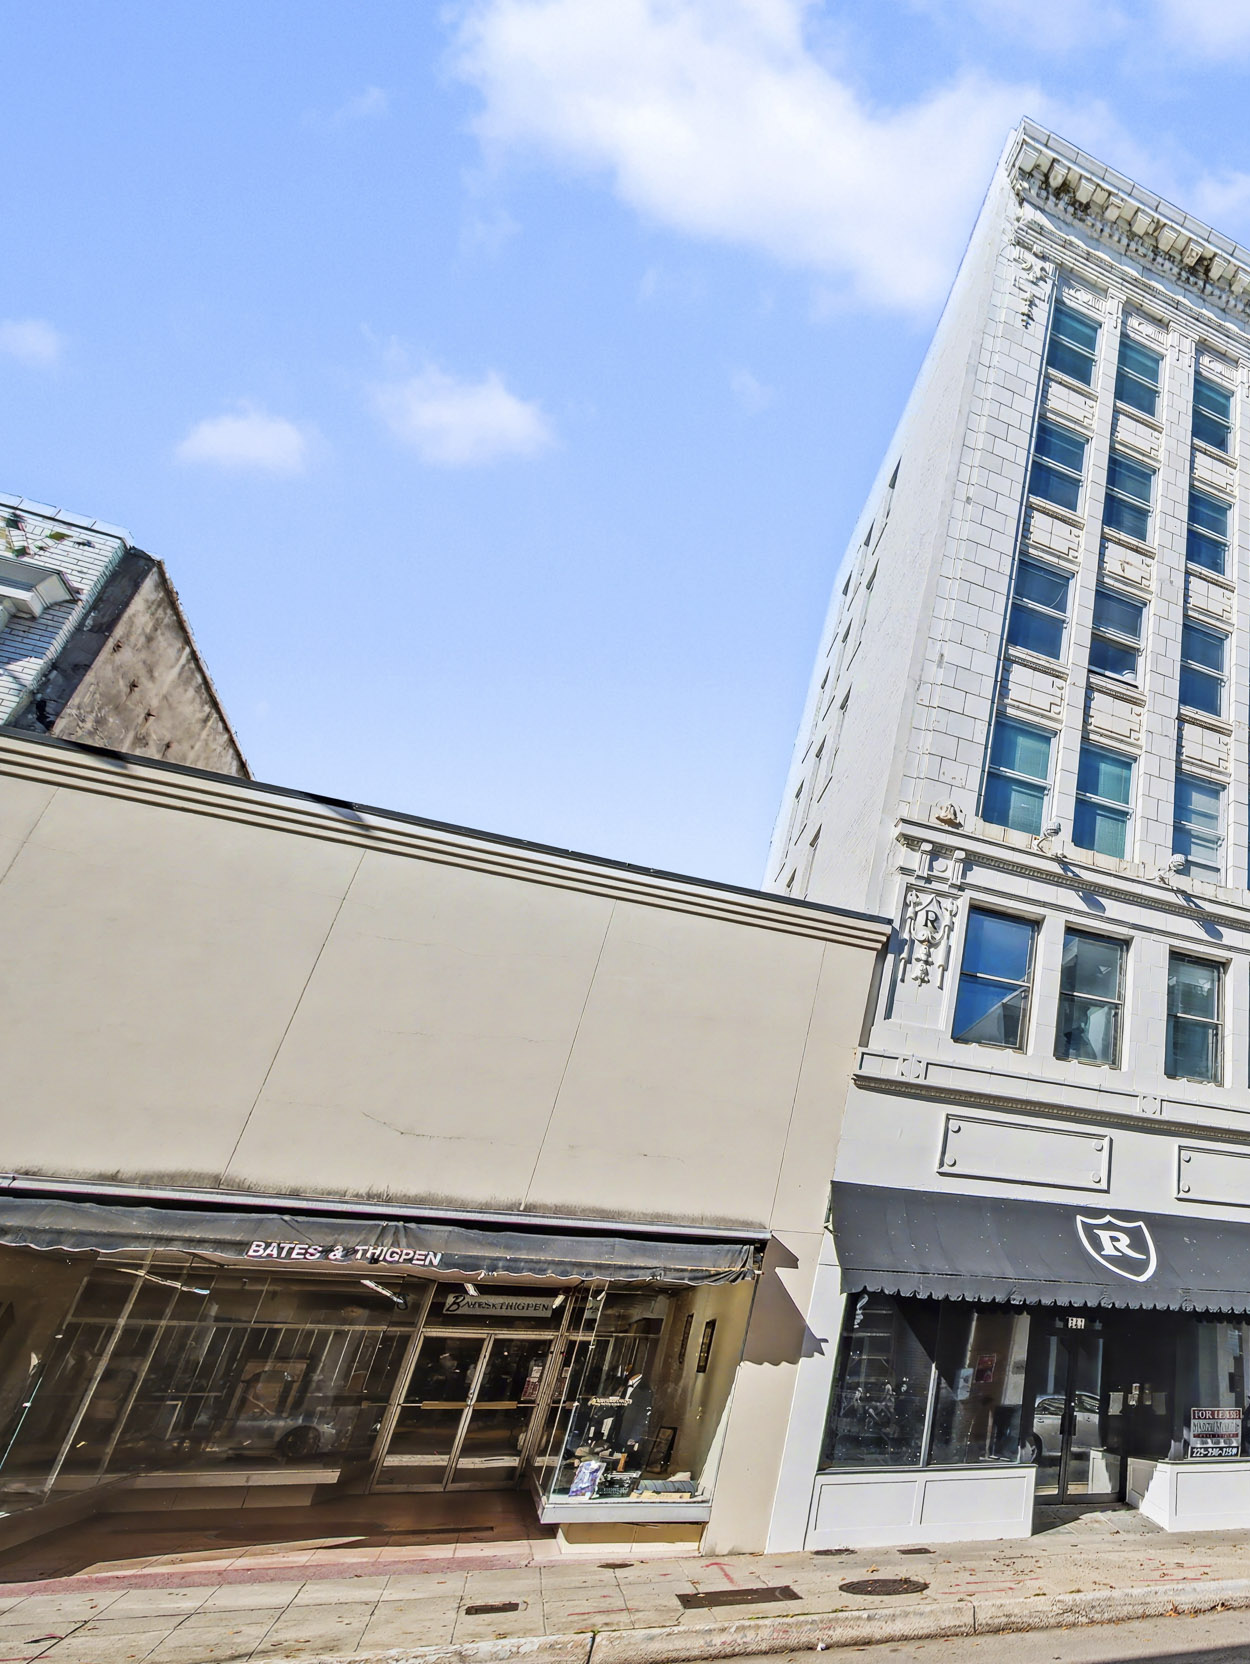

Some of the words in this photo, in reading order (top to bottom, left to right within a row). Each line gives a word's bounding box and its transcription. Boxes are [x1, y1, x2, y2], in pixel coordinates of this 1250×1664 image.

[922, 909, 939, 934] R
[245, 1241, 322, 1260] BATES
[328, 1245, 344, 1260] &
[354, 1245, 442, 1267] THIGPEN
[1093, 1229, 1147, 1259] R
